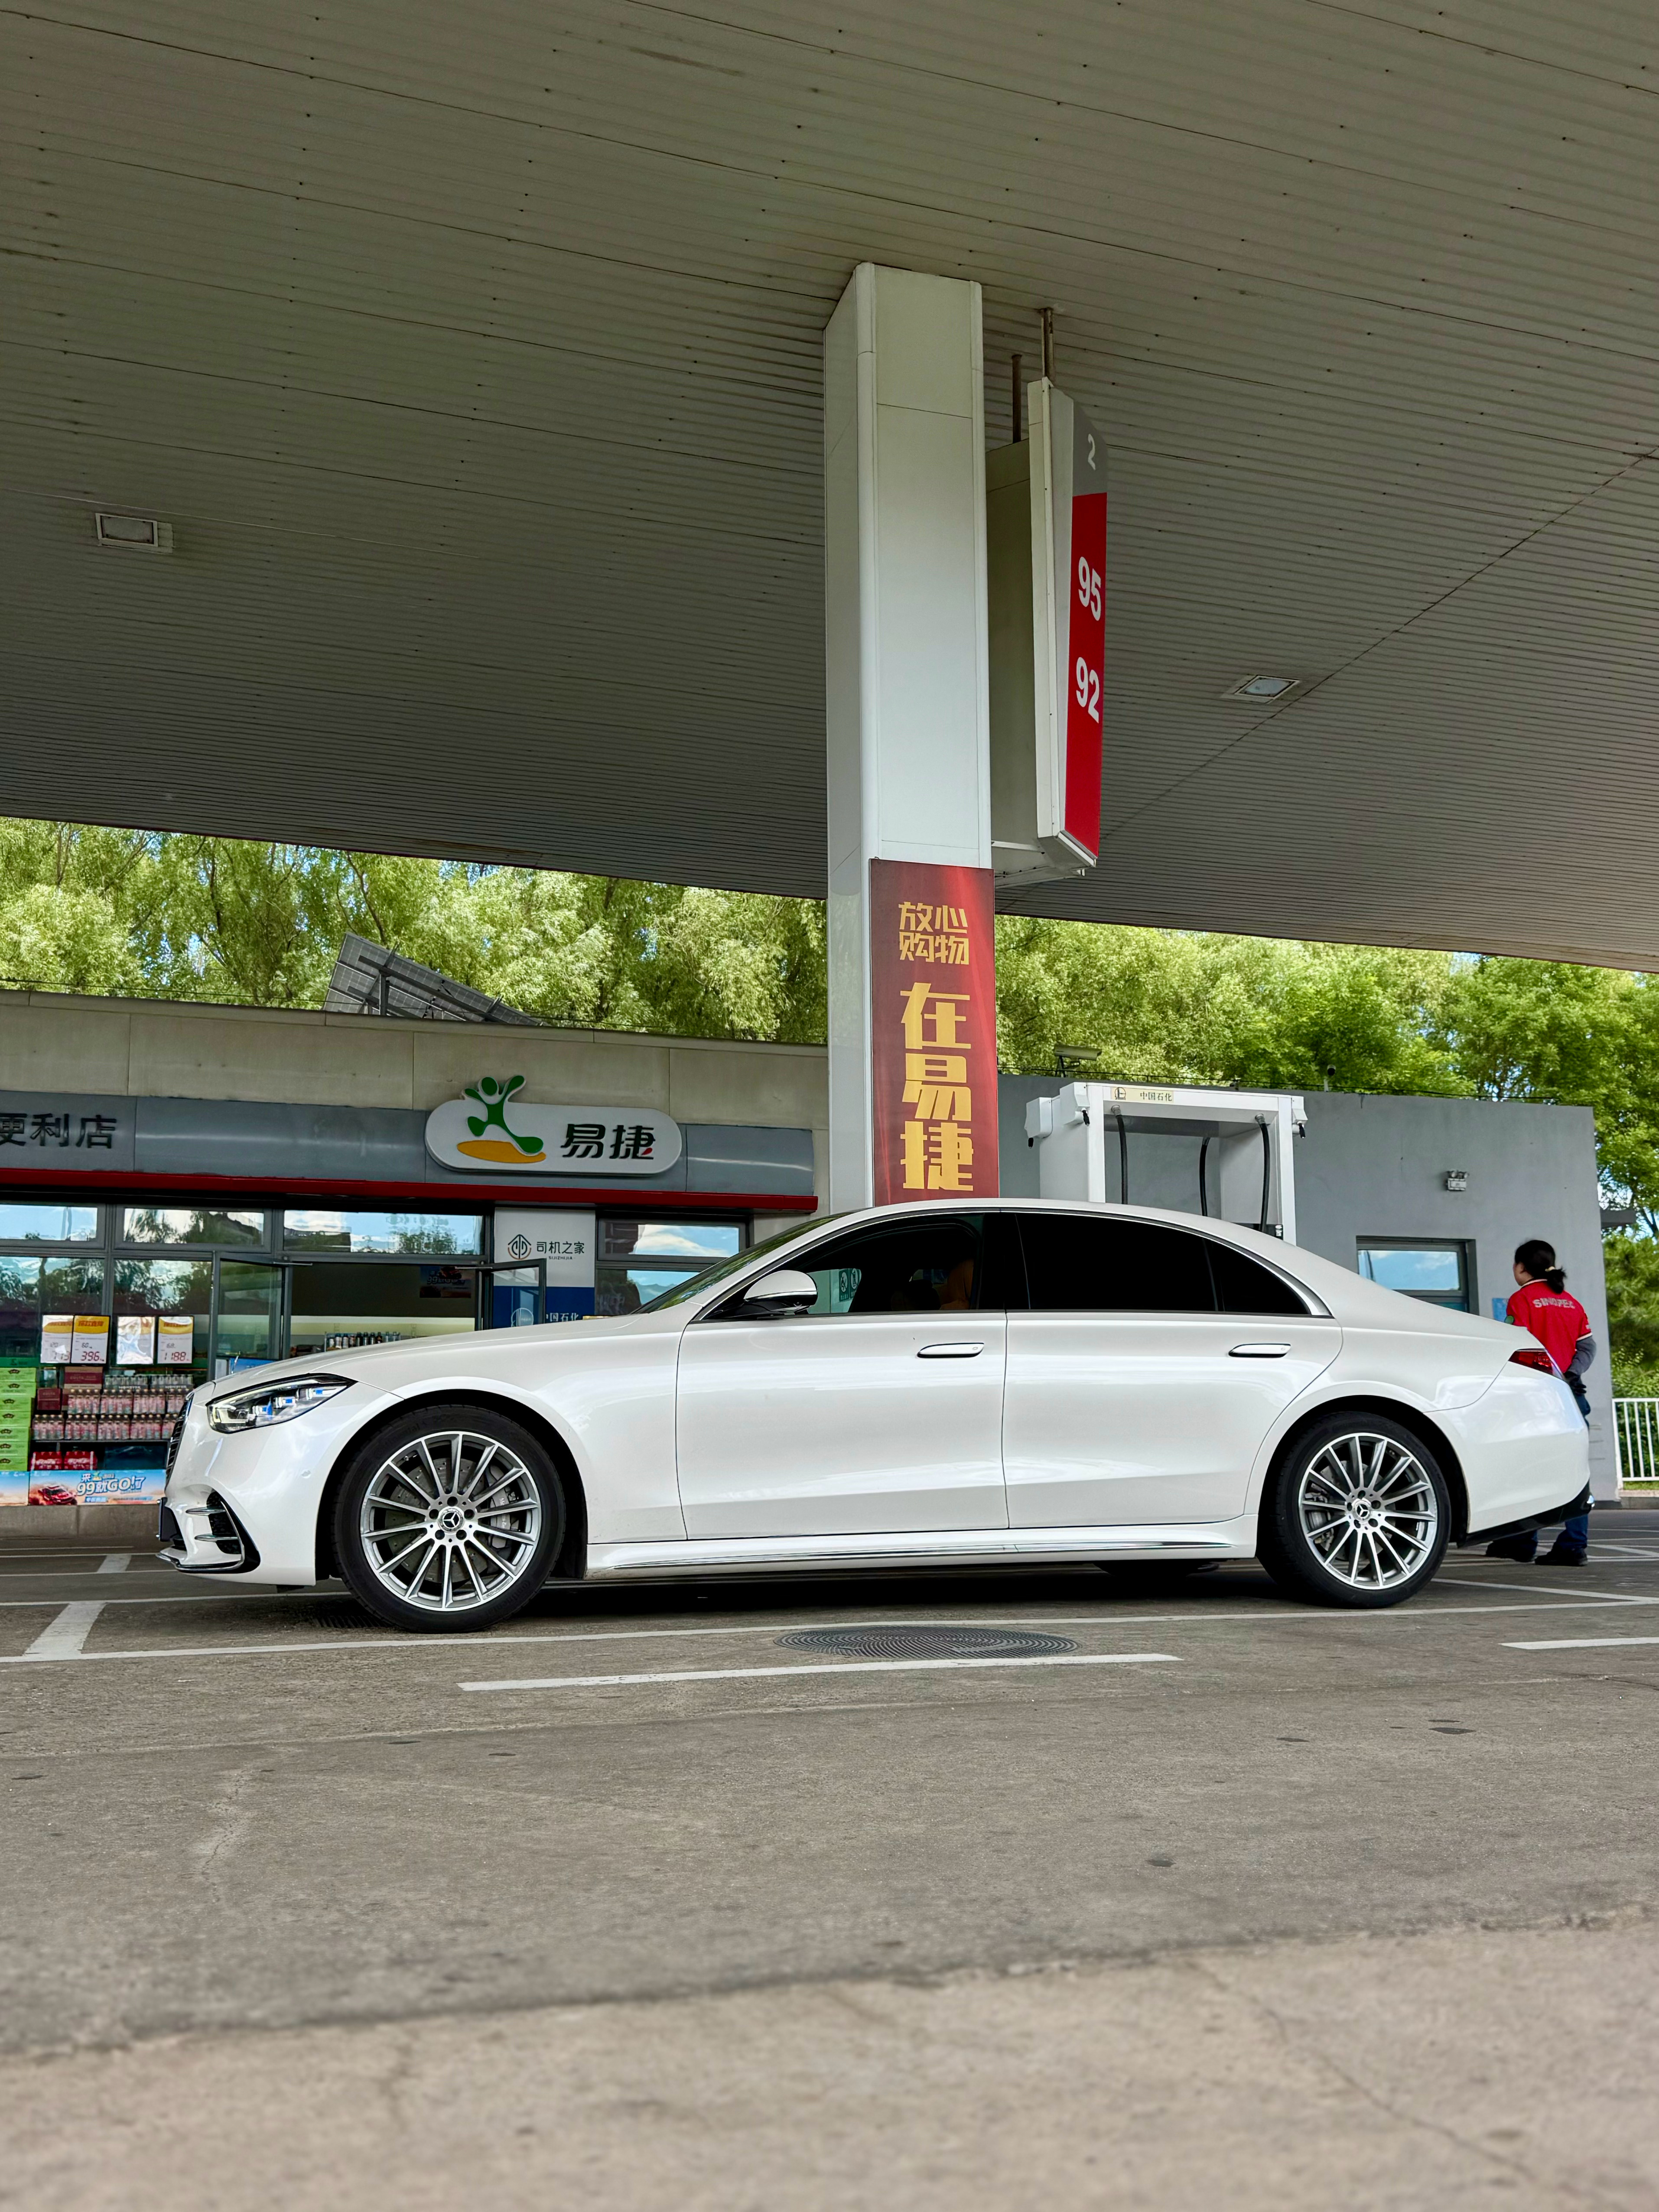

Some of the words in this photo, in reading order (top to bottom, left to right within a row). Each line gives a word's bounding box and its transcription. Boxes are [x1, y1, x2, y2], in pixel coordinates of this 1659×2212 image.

[1088, 433, 1096, 470] 2
[1078, 556, 1101, 621] 95
[1076, 657, 1099, 723] 92
[898, 901, 967, 934] 放心
[899, 931, 969, 965] 购物
[900, 982, 974, 1191] 在易捷
[1140, 1091, 1172, 1102] 中国石化
[560, 1123, 656, 1160] 易捷
[537, 1241, 585, 1254] 司机之家
[546, 1312, 579, 1322] 国石化
[81, 1351, 100, 1361] 396
[164, 1352, 186, 1361] 1188
